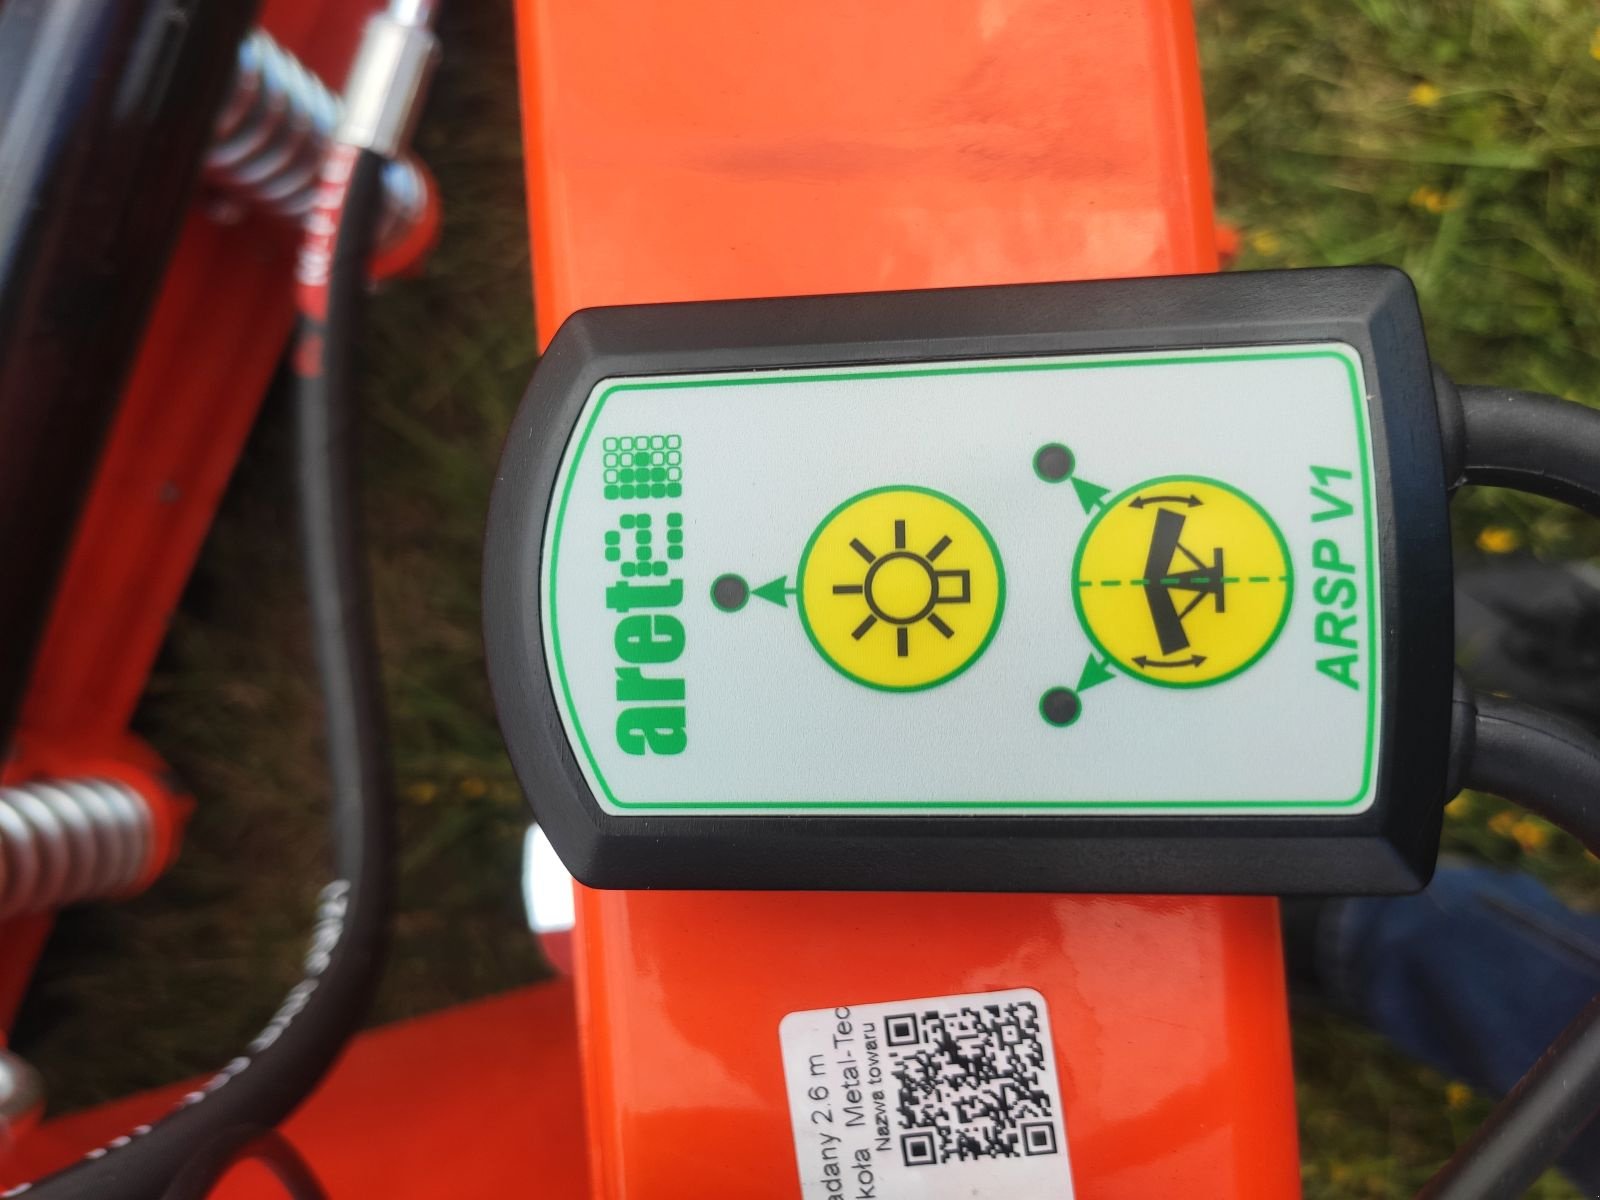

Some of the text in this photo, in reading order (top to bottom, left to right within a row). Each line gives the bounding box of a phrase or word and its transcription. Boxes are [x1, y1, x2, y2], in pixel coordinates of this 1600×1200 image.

[1310, 464, 1360, 691] ARSP V1
[808, 1054, 827, 1076] m
[808, 1085, 834, 1124] 2.6
[862, 1022, 893, 1152] Nazwa towaru
